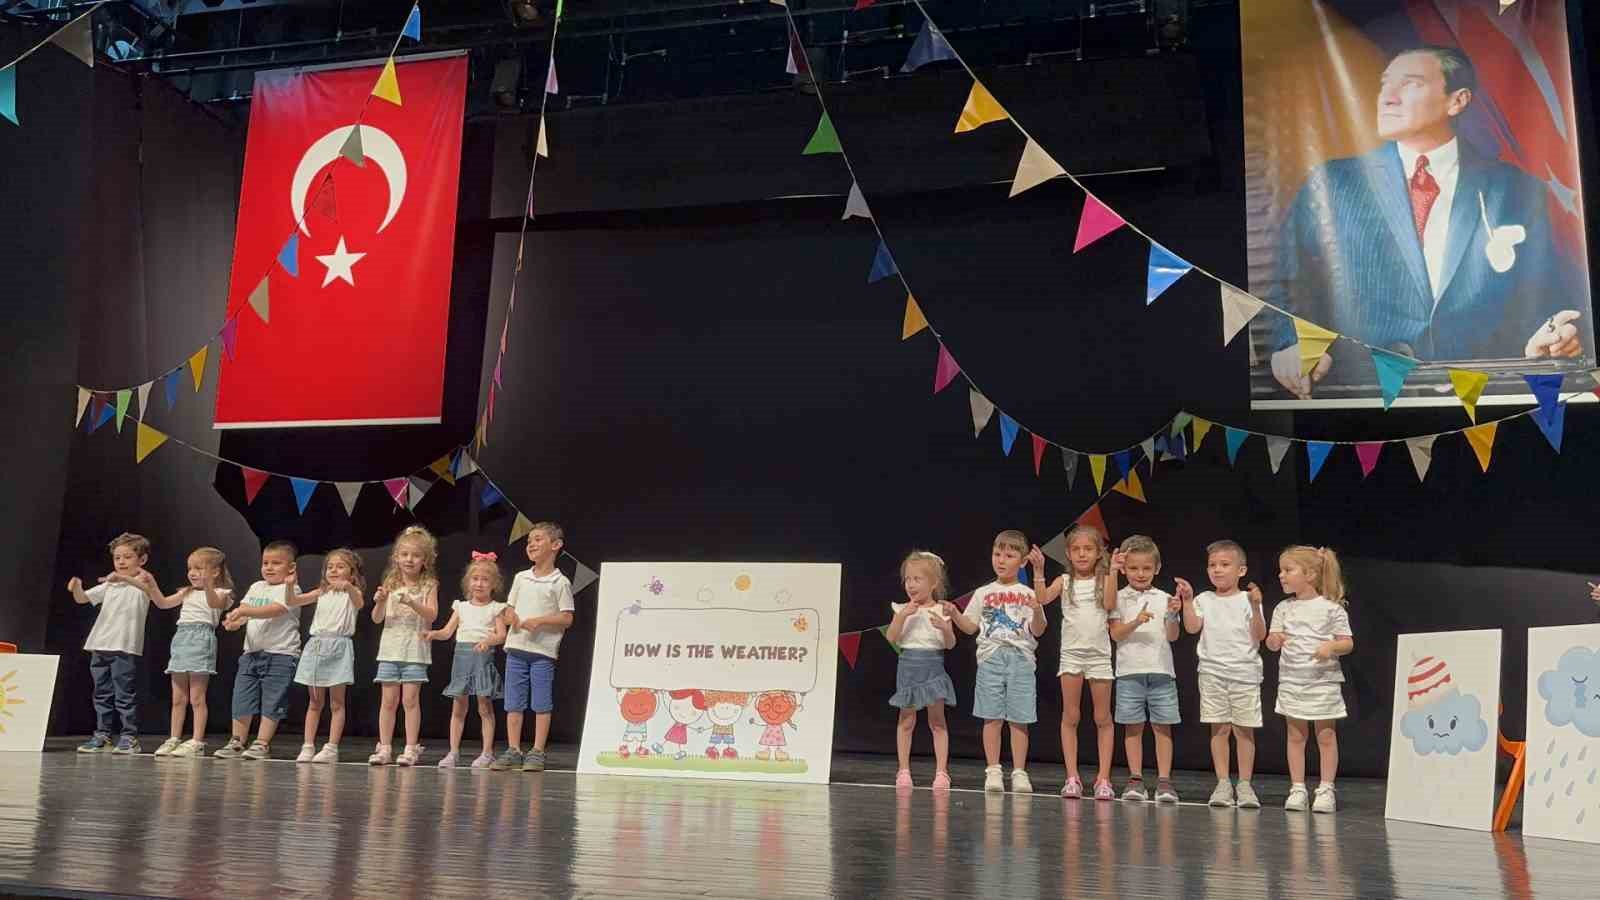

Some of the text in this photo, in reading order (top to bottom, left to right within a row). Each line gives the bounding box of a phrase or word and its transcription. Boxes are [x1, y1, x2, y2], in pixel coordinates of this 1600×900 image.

[624, 643, 808, 662] HOW IS THE WEATHER?
